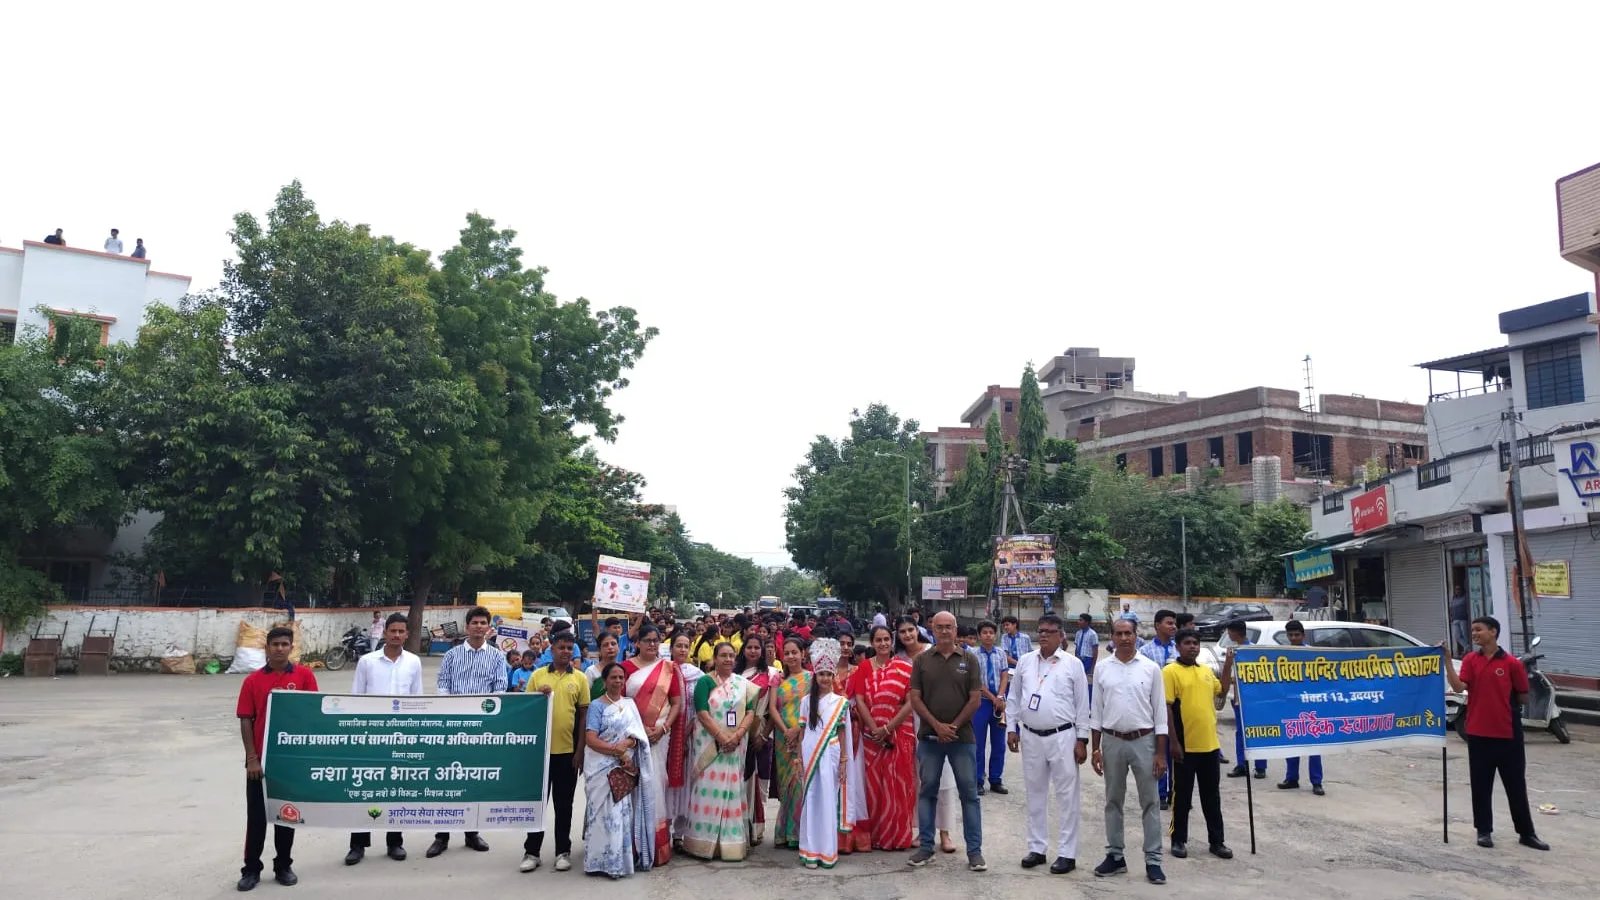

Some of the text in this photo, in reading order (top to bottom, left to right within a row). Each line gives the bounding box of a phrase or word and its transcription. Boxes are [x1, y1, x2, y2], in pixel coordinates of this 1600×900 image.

[1237, 651, 1441, 684] महावीर विद्या मन्दिर माध्यमिक विद्यालय
[1300, 692, 1329, 703] सेक्टर
[1350, 690, 1385, 704] उदयपुर
[1245, 725, 1281, 738] आपका
[1283, 710, 1335, 739] हार्दिक
[1338, 713, 1396, 734] स्वागत
[1396, 714, 1421, 728] करता
[278, 732, 537, 745] जिला प्रशासन एवं सामाजिक न्याय अधिकारिता विभाग
[310, 761, 502, 787] नशा मुक्त भारत अभियान
[388, 806, 465, 817] आरोग्य सेवा संस्थान
